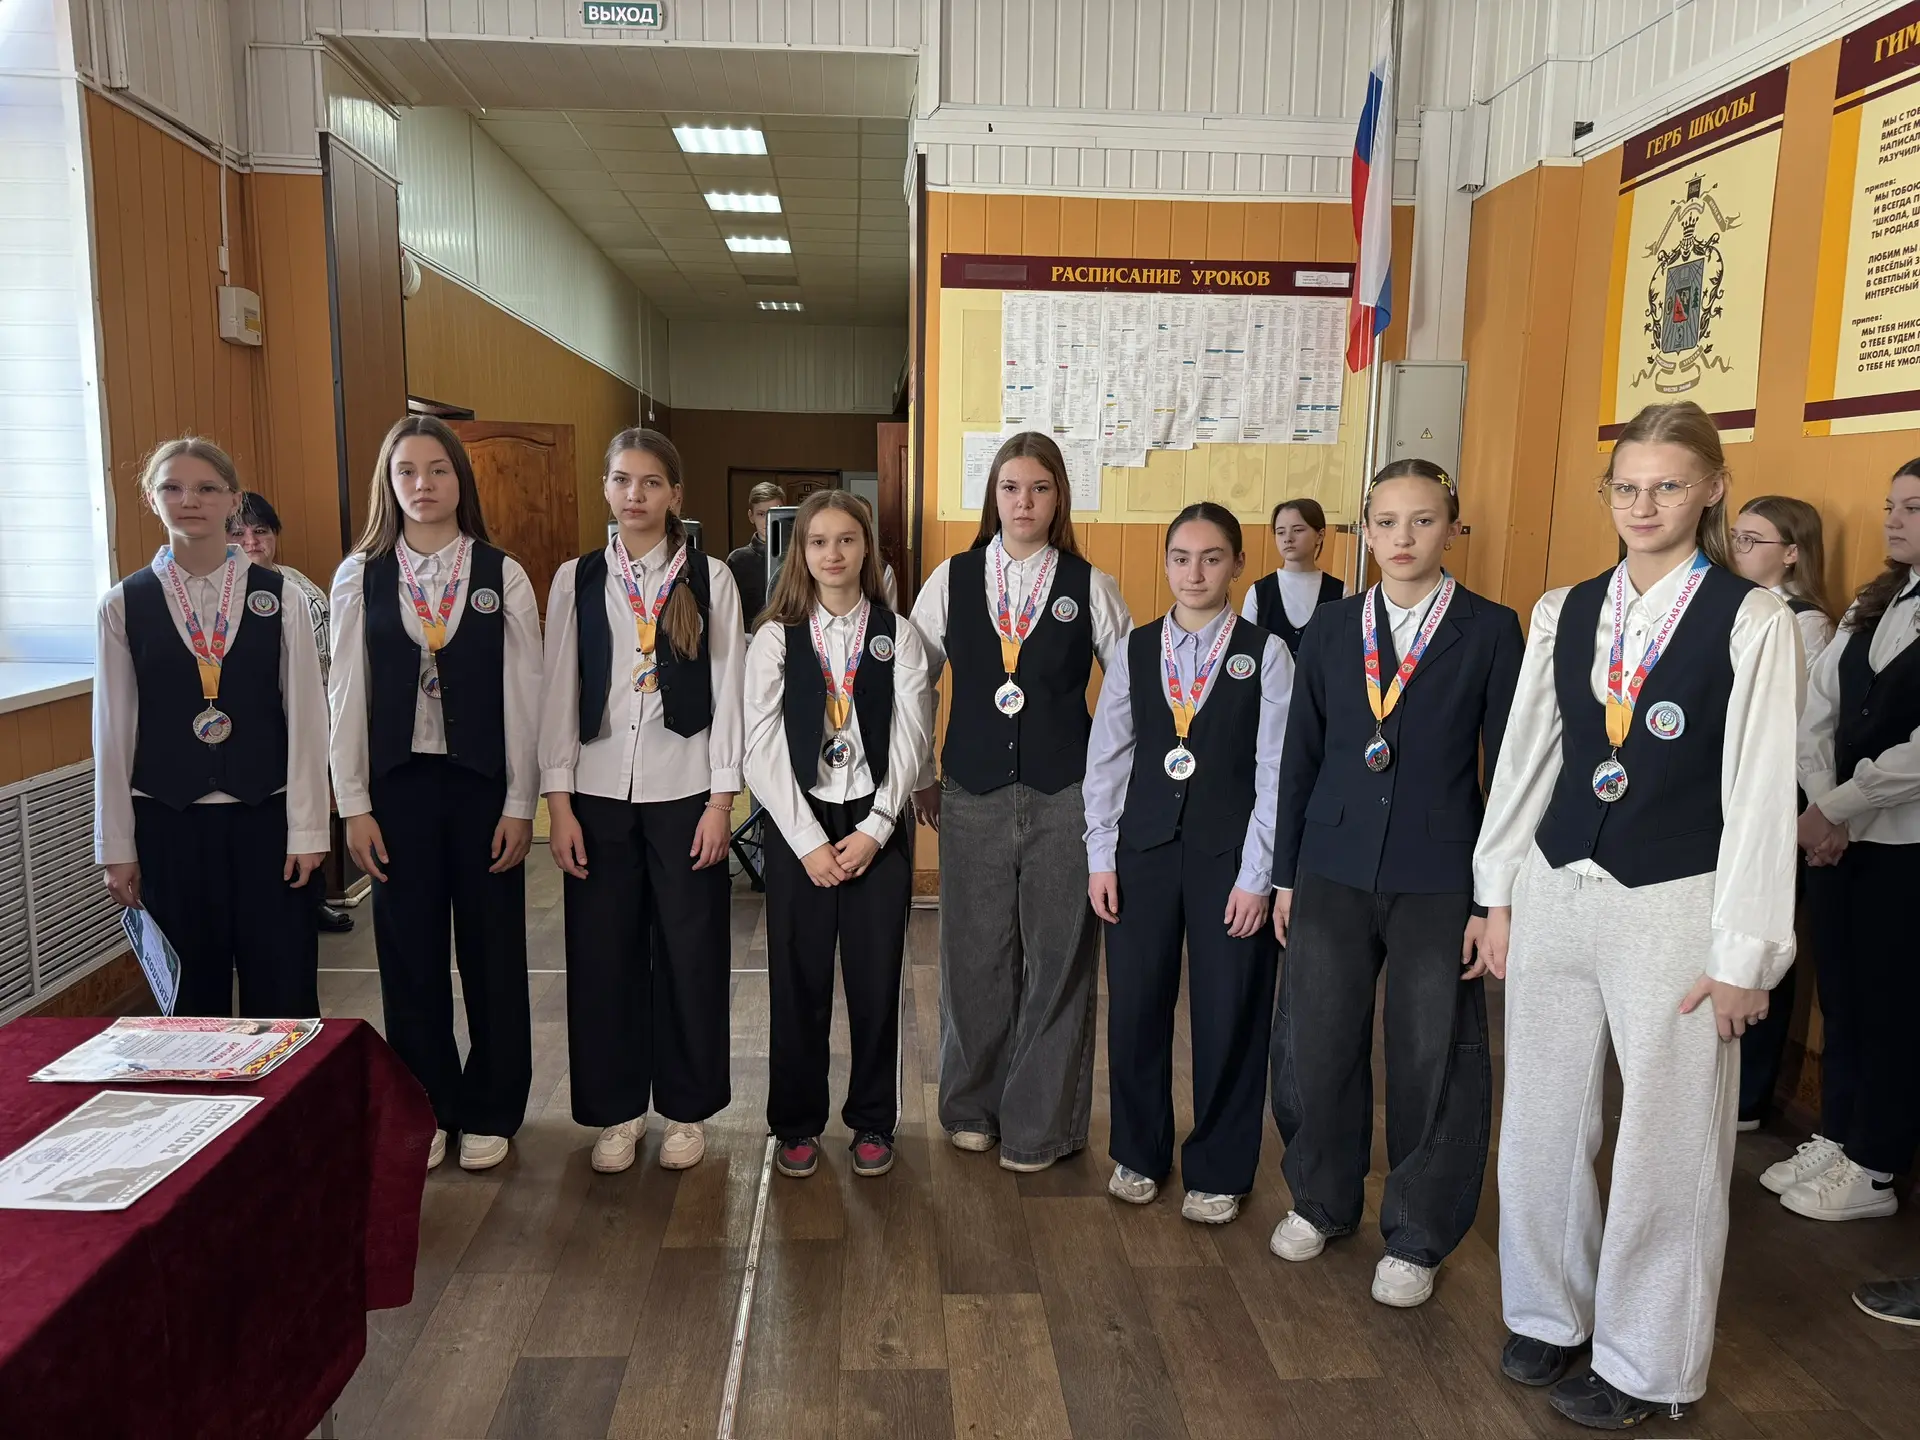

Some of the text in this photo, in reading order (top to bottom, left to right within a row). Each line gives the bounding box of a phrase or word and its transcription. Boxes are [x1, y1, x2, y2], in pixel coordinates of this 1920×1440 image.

[588, 5, 654, 24] ВЫХОД
[1645, 91, 1757, 159] ГЕРБ ШКОЛЫ
[1882, 115, 1897, 128] МЫ
[1898, 112, 1905, 121] С
[1880, 122, 1912, 140] ВМЕСТЕ
[1864, 178, 1897, 194] припев:
[1874, 190, 1889, 202] МЫ
[1873, 205, 1880, 215] И
[1881, 197, 1911, 213] ВСЕГДА
[1871, 219, 1920, 239] ТЫ РОДНАЯ
[1868, 244, 1918, 264] ЛЮБИМ МЫ
[1867, 267, 1874, 276] И
[1875, 256, 1913, 274] ВЕСЁЛЫЙ
[1051, 265, 1271, 287] РАСПИСАНИЕ УРОКОВ
[1866, 279, 1872, 288] В
[1873, 269, 1911, 286] СВЕТЛЫЙ
[1865, 279, 1919, 300] ИНТЕРЕСНЫЙ
[1851, 314, 1883, 327] припев:
[1861, 327, 1876, 337] МЫ
[1877, 323, 1896, 334] ТЕБЯ
[1860, 341, 1867, 349] О
[1868, 336, 1886, 347] ТЕБЕ
[1887, 332, 1916, 344] БУДЕМ
[1859, 349, 1892, 361] ШКОЛА,
[1858, 364, 1864, 372] О
[1866, 361, 1884, 371] ТЕБЕ
[1885, 359, 1896, 369] НЕ
[1365, 601, 1374, 650] ВОРОНЕЖСКАЯ
[1642, 606, 1680, 666] ВОРОНЕЖСКАЯ
[1675, 571, 1700, 608] ОБЛАСТЬ
[1412, 605, 1443, 656] ВОРОНЕЖСКАЯ
[1612, 600, 1622, 659] ВОРОНЕЖСКАЯ
[158, 1103, 238, 1154] ДИПЛОМ
